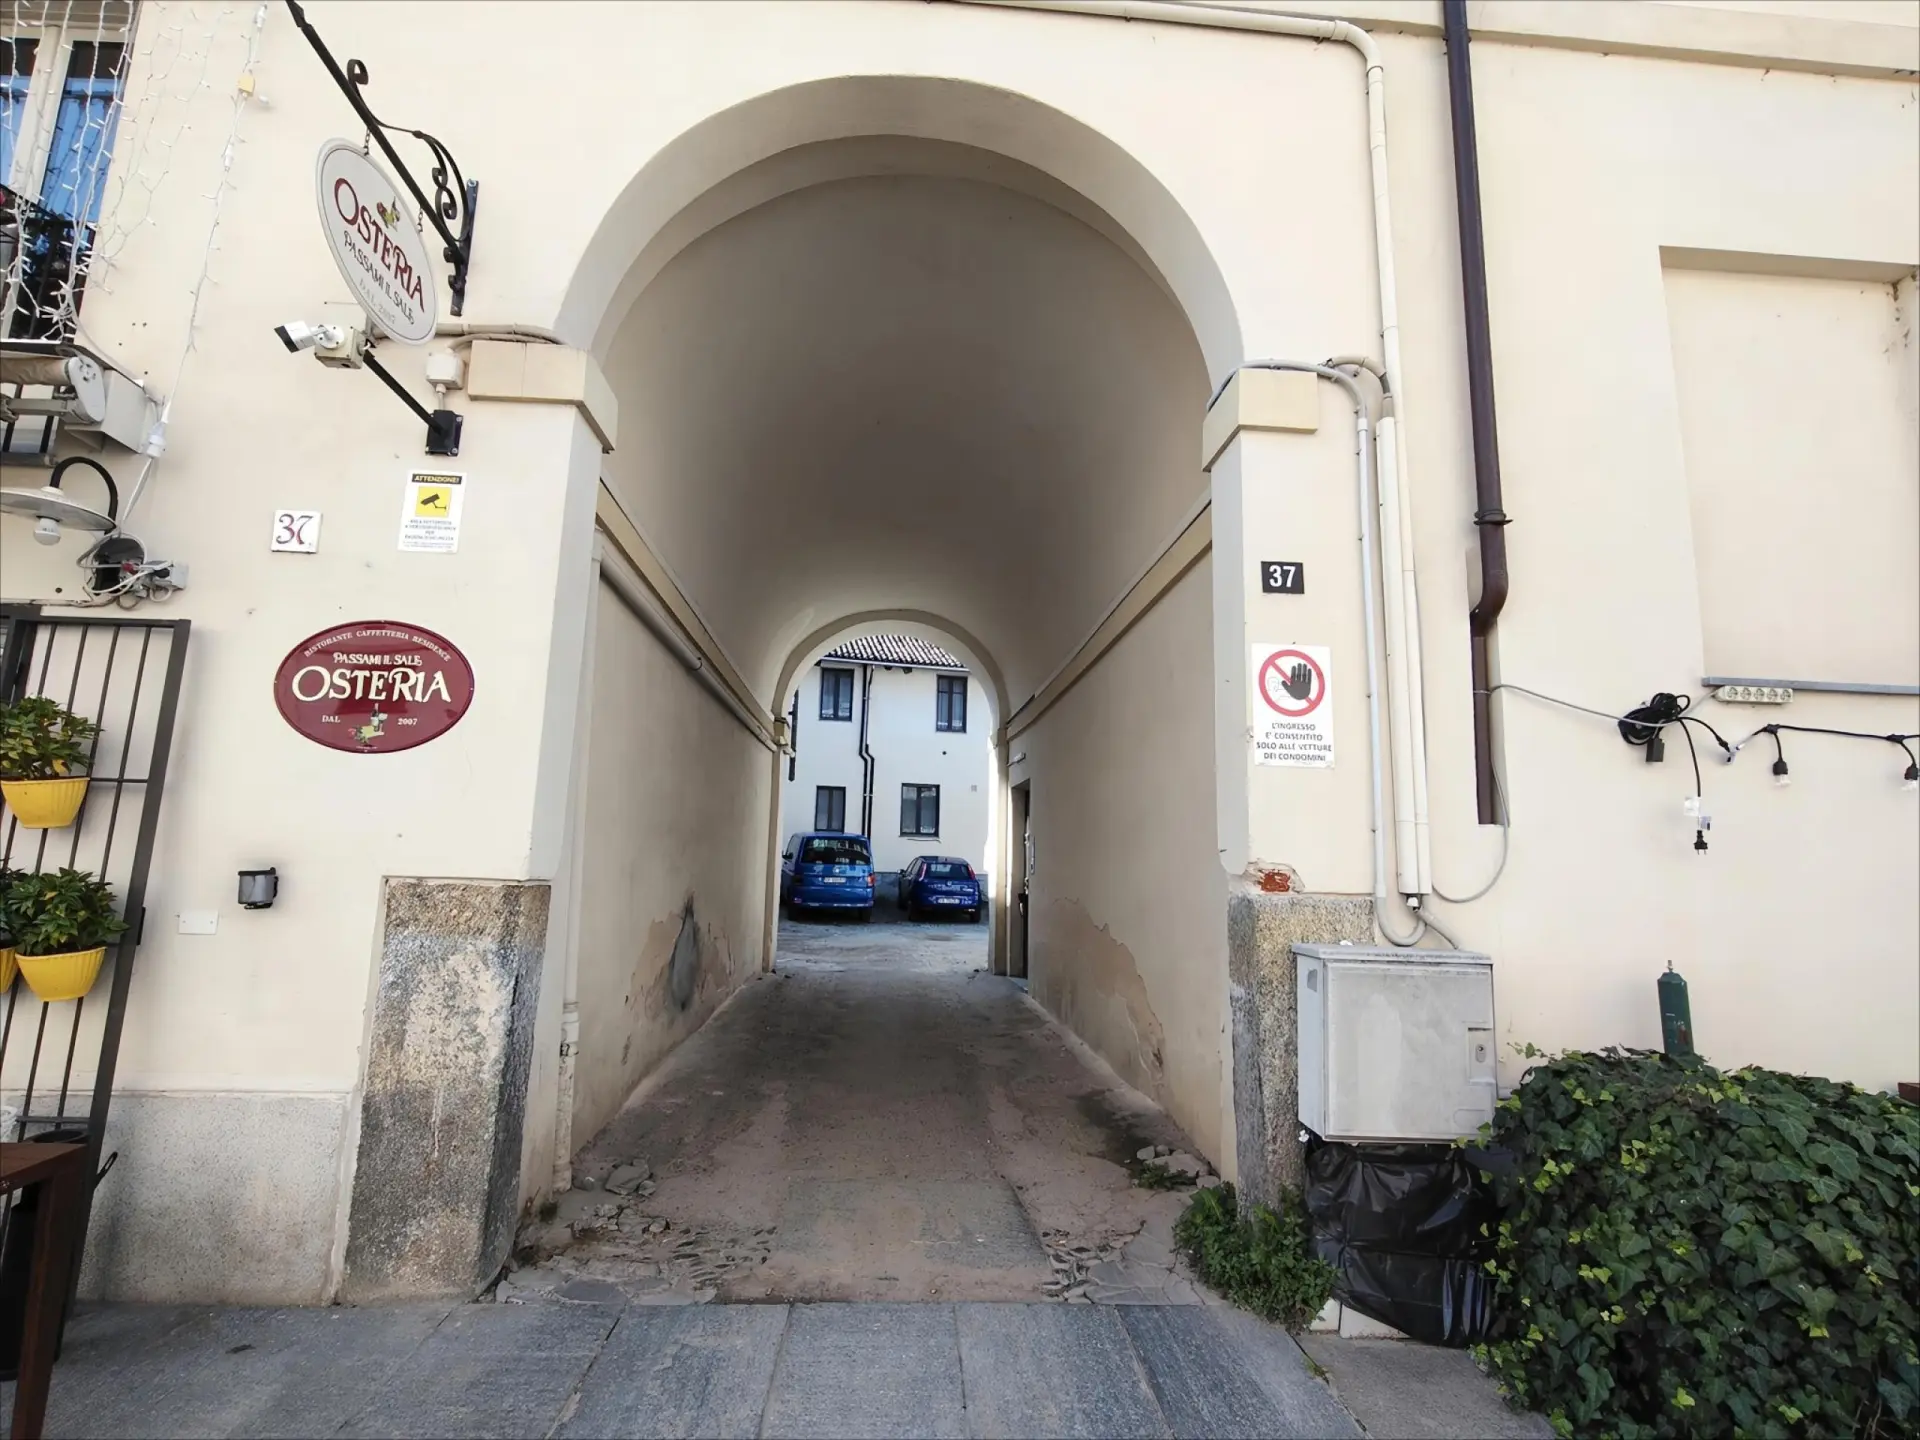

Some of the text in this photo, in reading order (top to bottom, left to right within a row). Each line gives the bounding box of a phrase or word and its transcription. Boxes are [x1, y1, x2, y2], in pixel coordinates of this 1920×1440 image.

[334, 177, 425, 313] OSTERIA
[344, 230, 415, 325] PASSAMI IL SALE
[414, 475, 460, 484] ATTENZIONE!
[276, 513, 314, 545] 37
[1268, 564, 1297, 588] 37
[304, 629, 452, 662] RISTORANTE CAFFETTERIA RESIDENCE
[333, 652, 423, 667] PASSAMI IL SALE
[291, 665, 451, 703] OSTERIA
[321, 714, 418, 726] DAL 2007
[1271, 722, 1316, 731] L'INGRESSO
[1274, 732, 1323, 742] CONSENTITO
[1256, 741, 1277, 750] SOLO
[1298, 743, 1332, 752] VETTURE
[1263, 752, 1326, 762] DEI CONDOMINI
